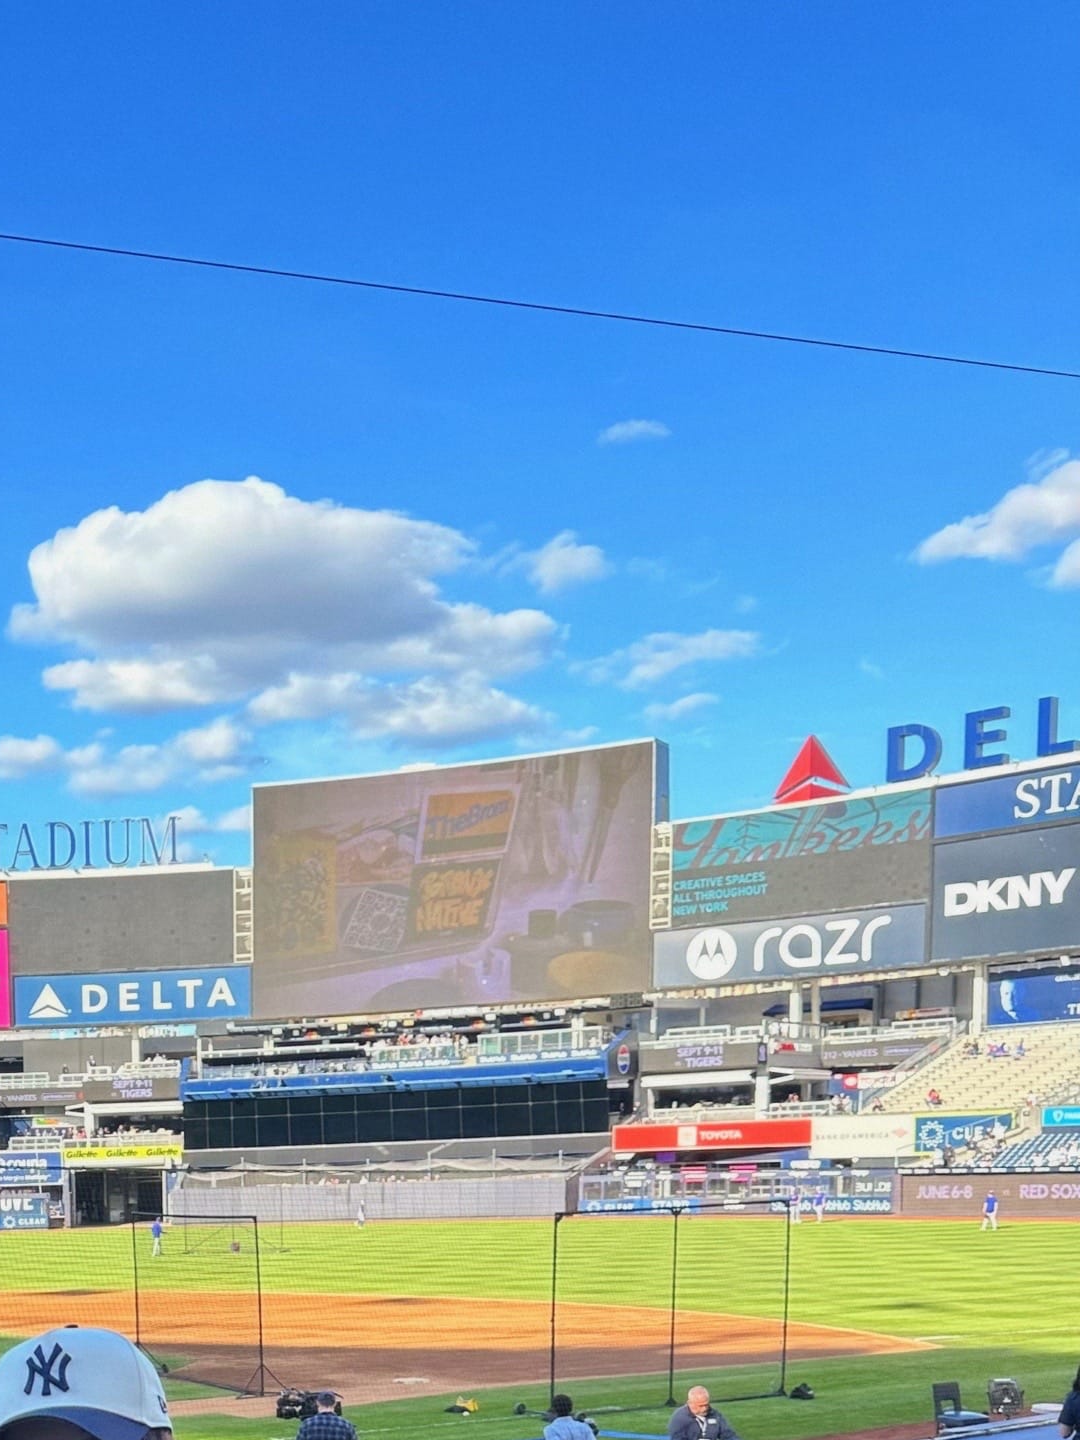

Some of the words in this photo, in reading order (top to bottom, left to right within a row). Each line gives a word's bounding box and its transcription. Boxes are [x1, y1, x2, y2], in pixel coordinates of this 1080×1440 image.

[886, 696, 1080, 783] DEL
[673, 797, 931, 869] Yankees
[674, 875, 723, 891] CREATIVE
[726, 872, 767, 885] SPACES
[674, 892, 693, 904] ALL
[695, 884, 767, 900] THROUGHOUT
[944, 867, 1076, 917] DKNY
[673, 905, 698, 916] NEW
[699, 903, 728, 914] YORK
[753, 915, 892, 972] razr
[81, 977, 236, 1014] DELTA
[677, 1046, 703, 1058] SEPT
[842, 1049, 878, 1058] YANKEES
[685, 1056, 723, 1067] TIGERS
[113, 1079, 135, 1089] SEPT
[120, 1088, 152, 1098] TIGERS
[699, 1130, 743, 1141] TOYOTA
[851, 1132, 889, 1140] AMERICA
[66, 1149, 98, 1159] Gillette
[106, 1148, 138, 1158] Gillette
[146, 1147, 178, 1157] Gillette
[917, 1185, 950, 1199] JUNE
[951, 1185, 973, 1199] 6-8
[1019, 1184, 1048, 1199] RED
[1051, 1183, 1080, 1199] SOX
[18, 1217, 47, 1226] CLEAR
[24, 1342, 72, 1396] NY
